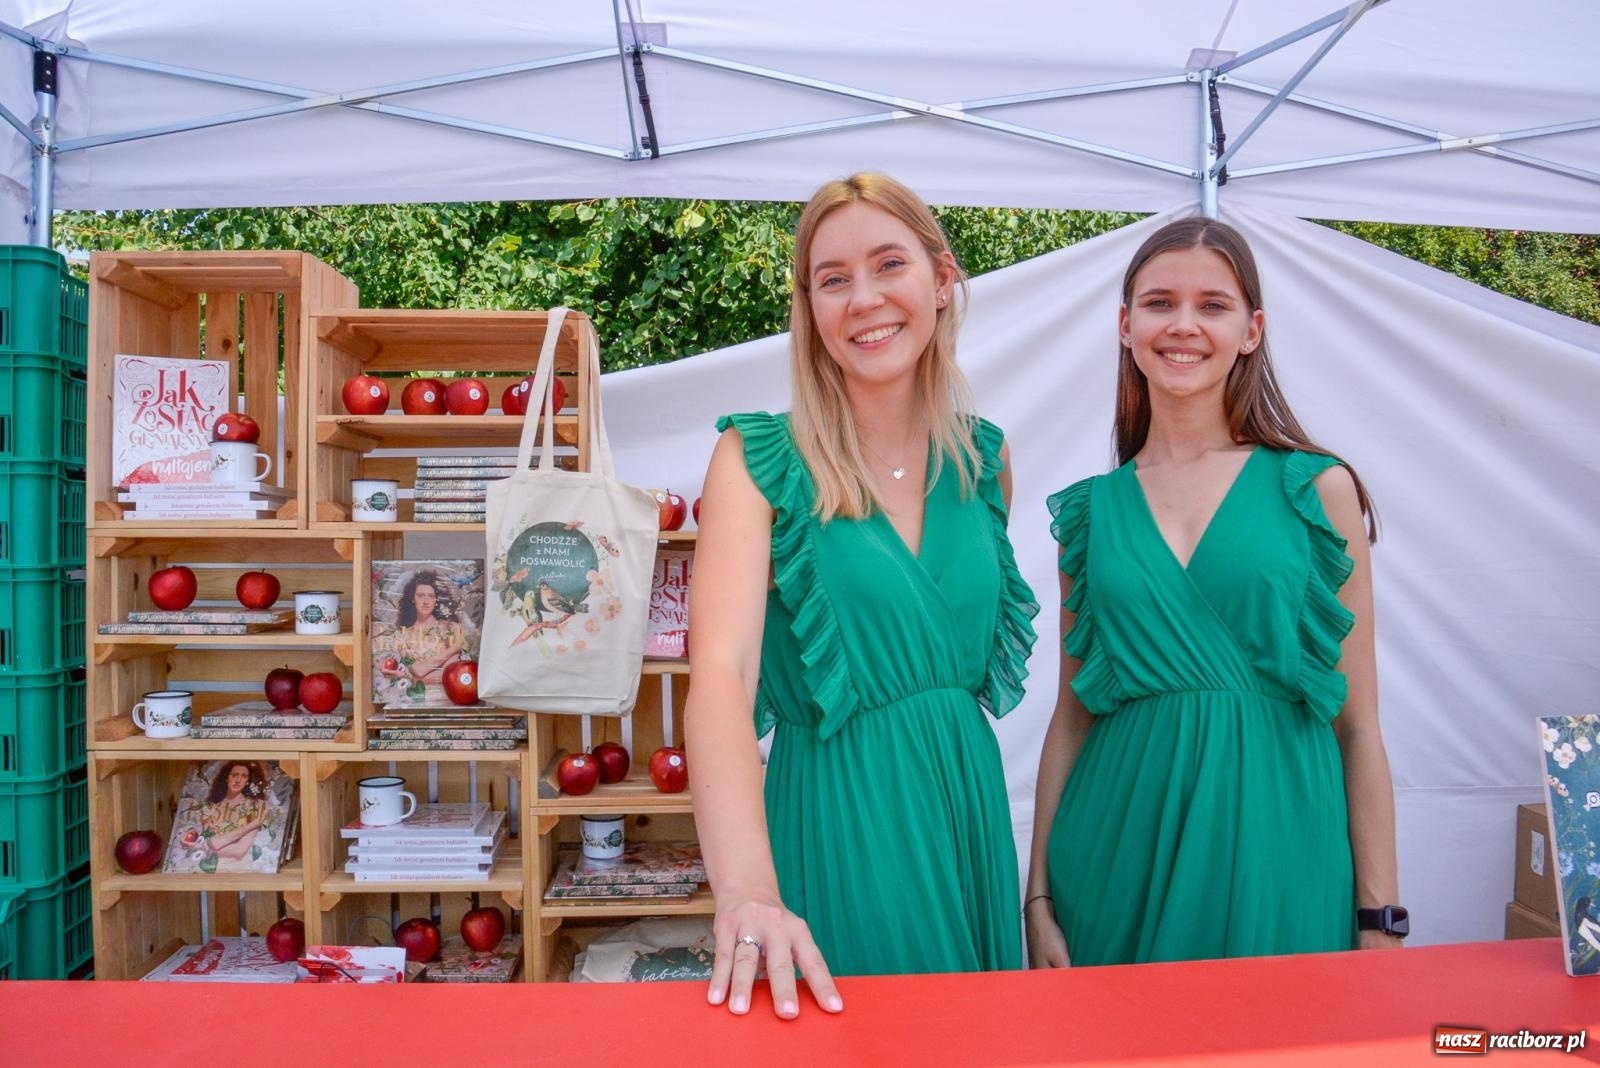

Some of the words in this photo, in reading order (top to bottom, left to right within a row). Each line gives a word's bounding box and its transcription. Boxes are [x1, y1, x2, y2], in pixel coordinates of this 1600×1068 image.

[132, 369, 215, 411] Jak
[543, 547, 570, 556] NAMI
[520, 556, 586, 568] POSWAWOLIĆ
